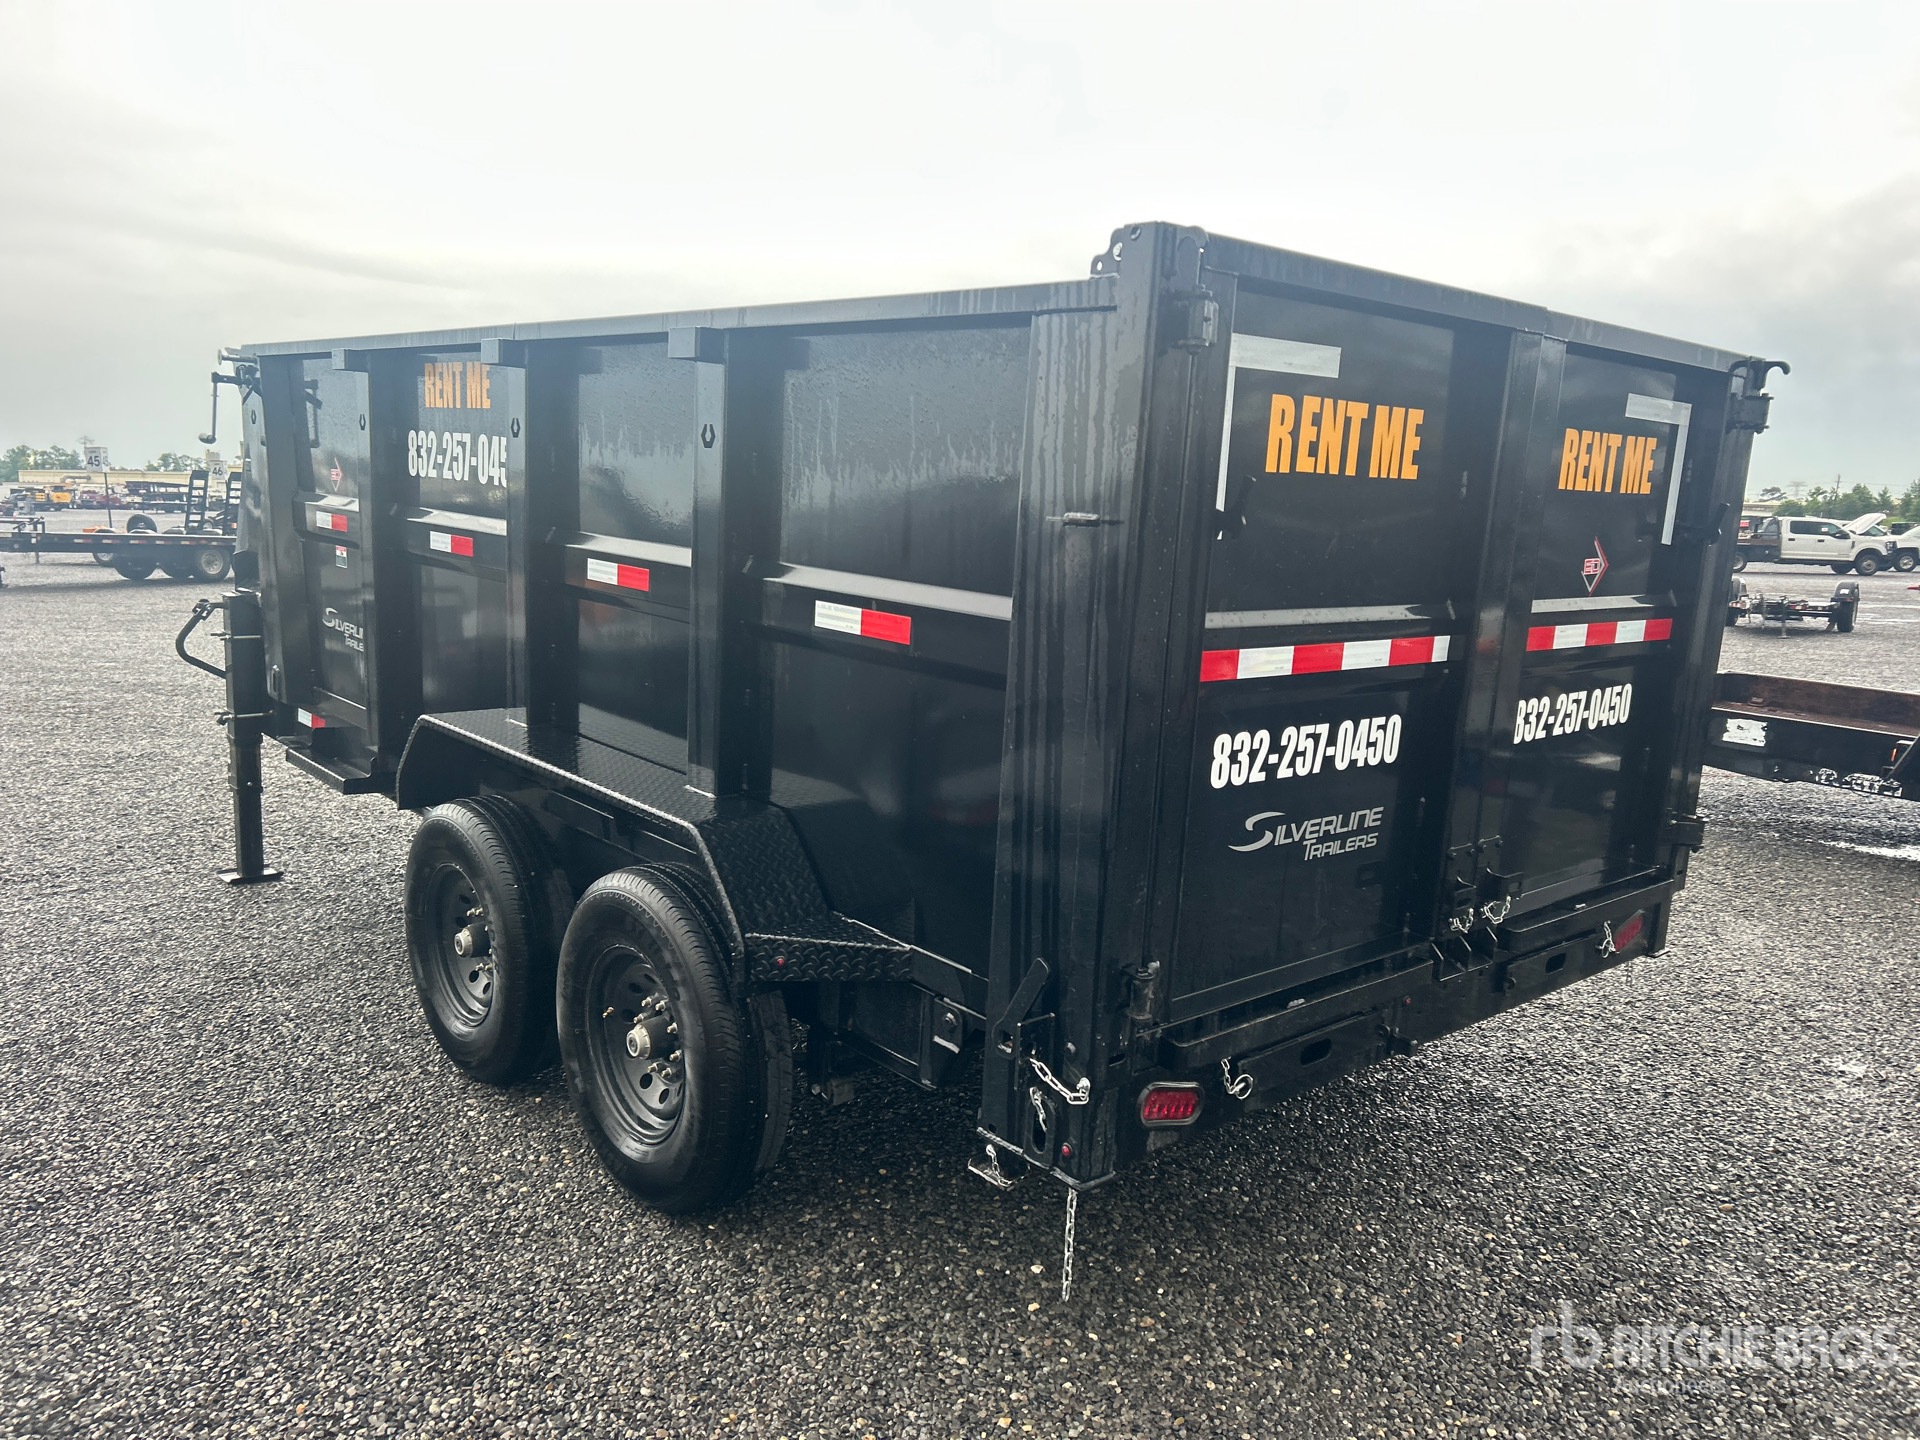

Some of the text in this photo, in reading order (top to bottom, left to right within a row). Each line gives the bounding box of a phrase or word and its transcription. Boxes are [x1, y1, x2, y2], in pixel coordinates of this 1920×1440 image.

[424, 361, 491, 409] RENT ME
[1265, 393, 1424, 480] RENT ME
[87, 455, 100, 467] 45
[212, 466, 223, 476] 46
[1558, 428, 1658, 495] RENT ME
[1513, 683, 1632, 744] 832-257-0450
[1210, 714, 1402, 789] 832-257-0450
[1228, 806, 1384, 852] SILVERLINE
[1303, 832, 1379, 861] TRAILERS
